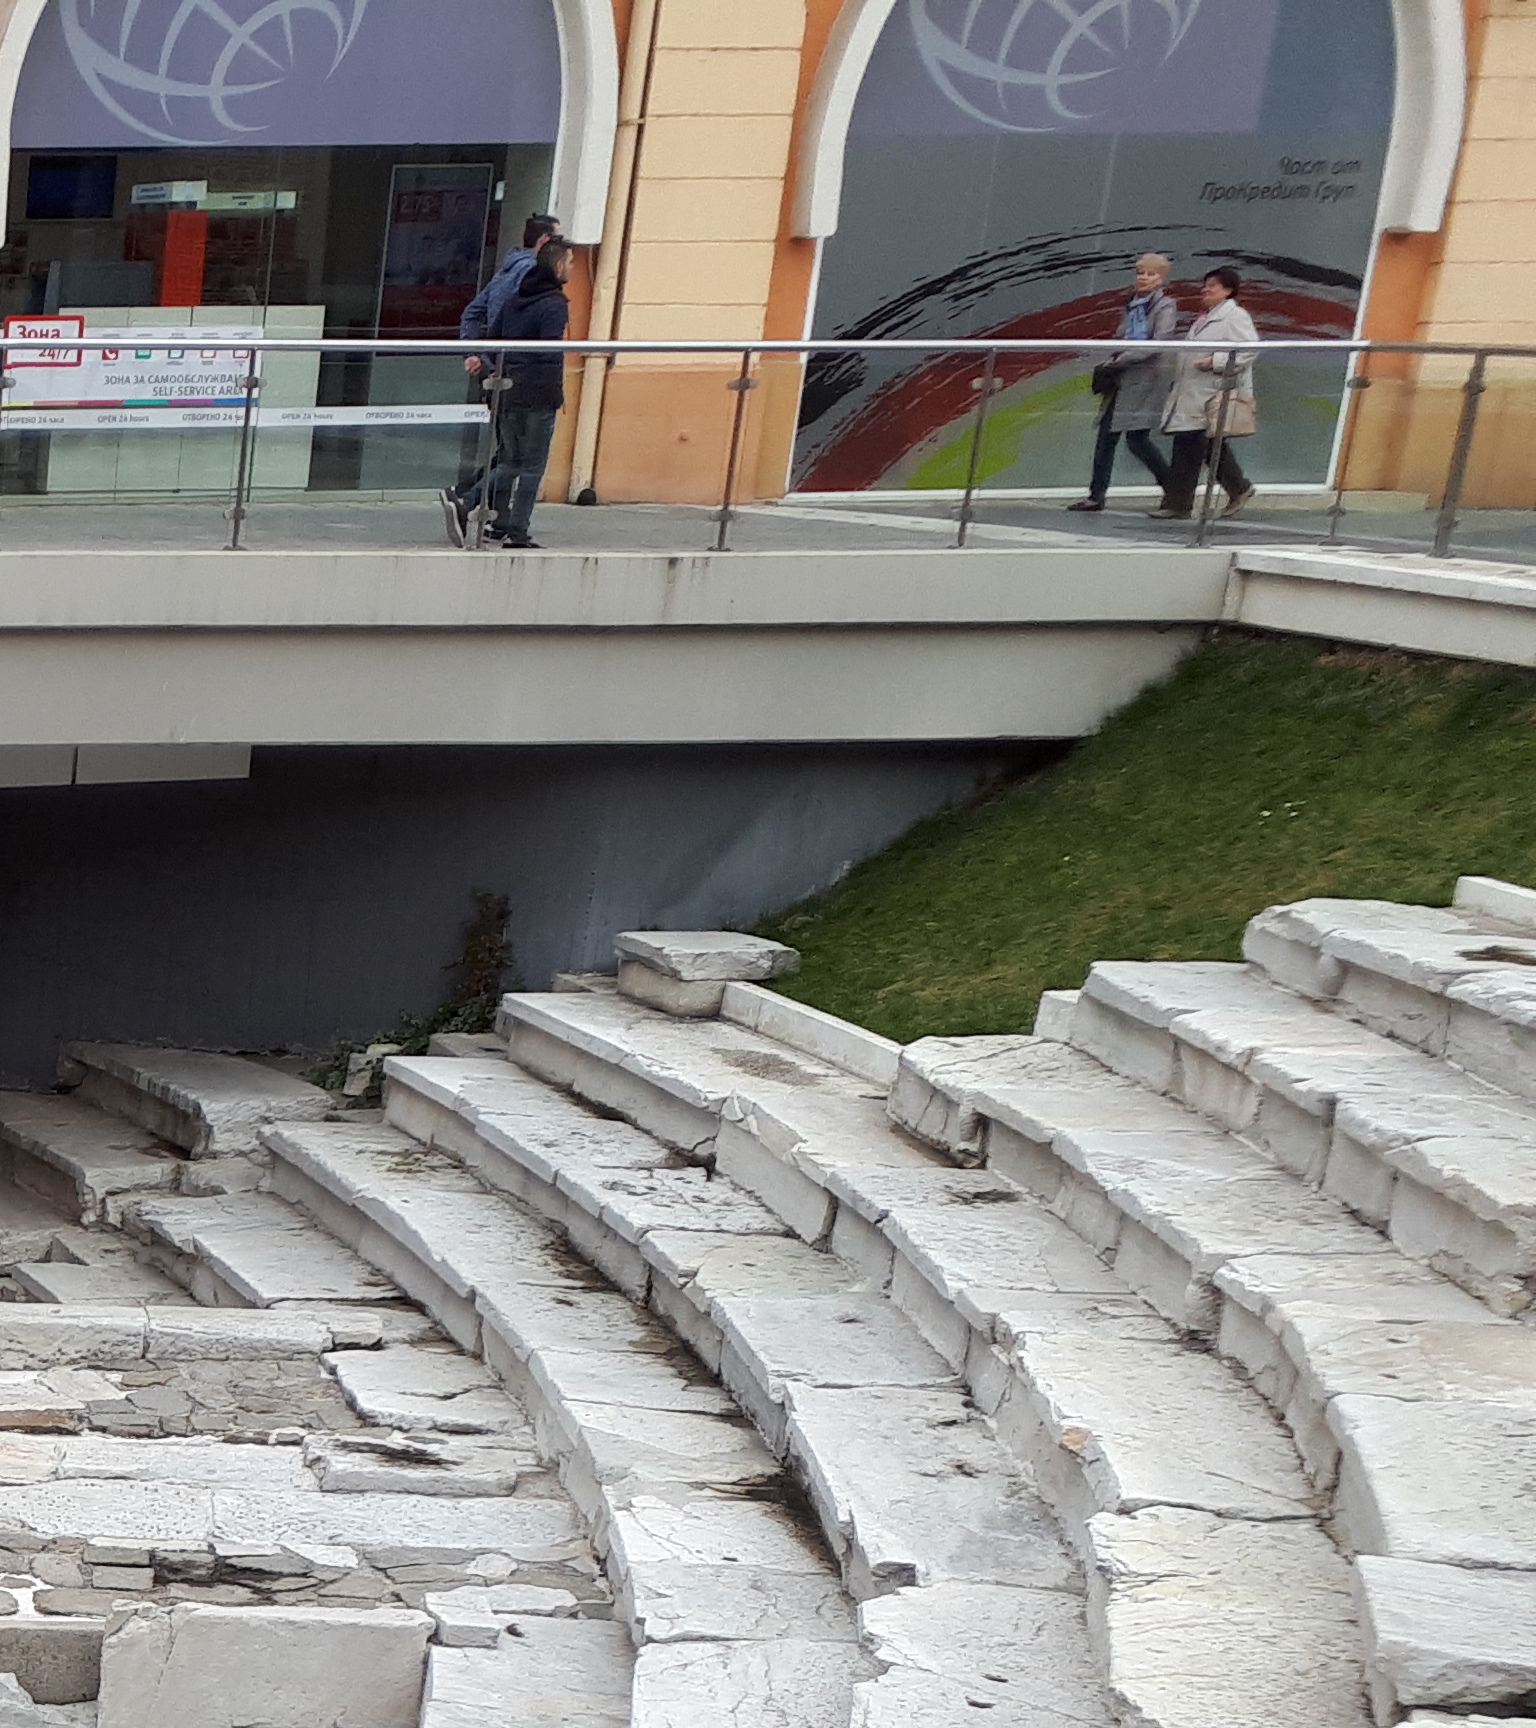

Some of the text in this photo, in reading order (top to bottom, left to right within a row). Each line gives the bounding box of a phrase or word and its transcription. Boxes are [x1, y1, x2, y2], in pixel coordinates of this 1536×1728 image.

[17, 324, 61, 339] Зона
[104, 375, 131, 385] ЗОНА
[133, 375, 146, 384] ЗА
[152, 386, 216, 396] SELF-SERVICE
